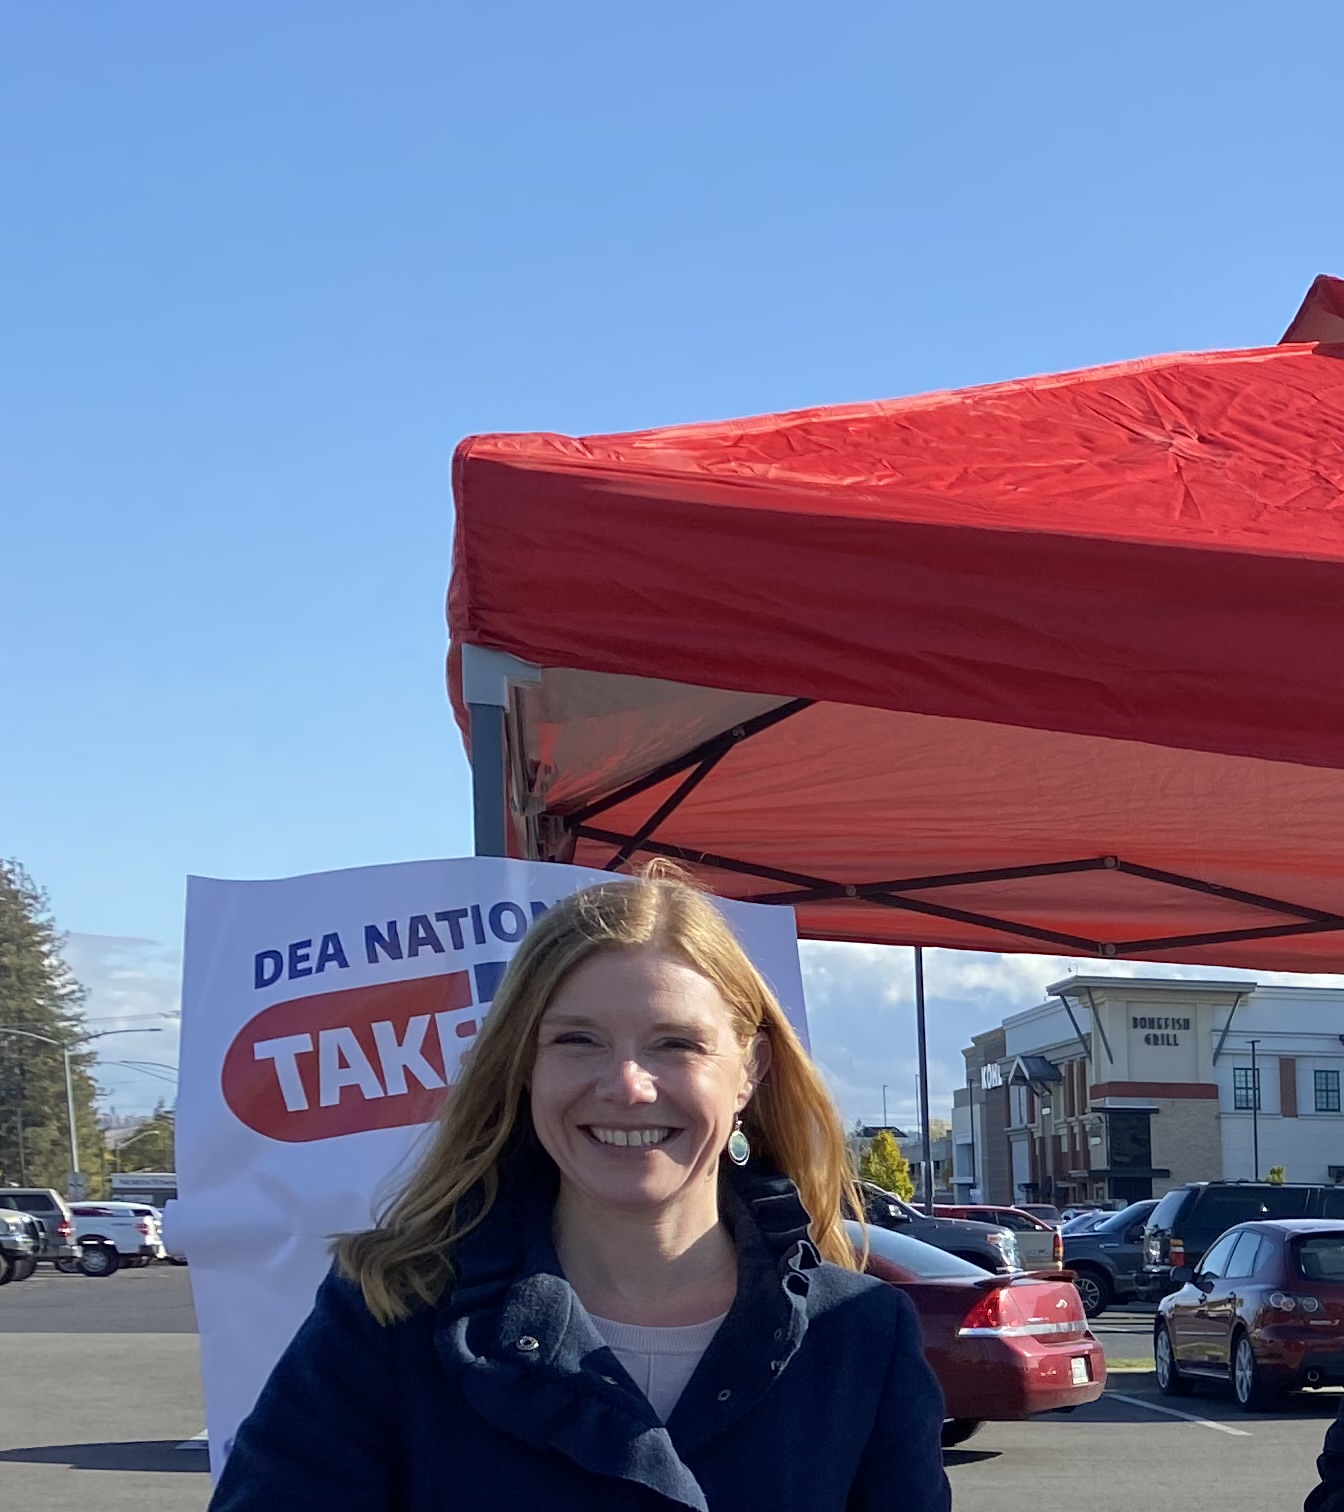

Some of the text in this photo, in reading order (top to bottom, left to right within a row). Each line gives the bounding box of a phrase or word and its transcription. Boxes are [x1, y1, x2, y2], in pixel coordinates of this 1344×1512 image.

[254, 931, 350, 990] DEA
[1132, 1016, 1190, 1031] BONEFISH
[1144, 1033, 1180, 1047] GRILL
